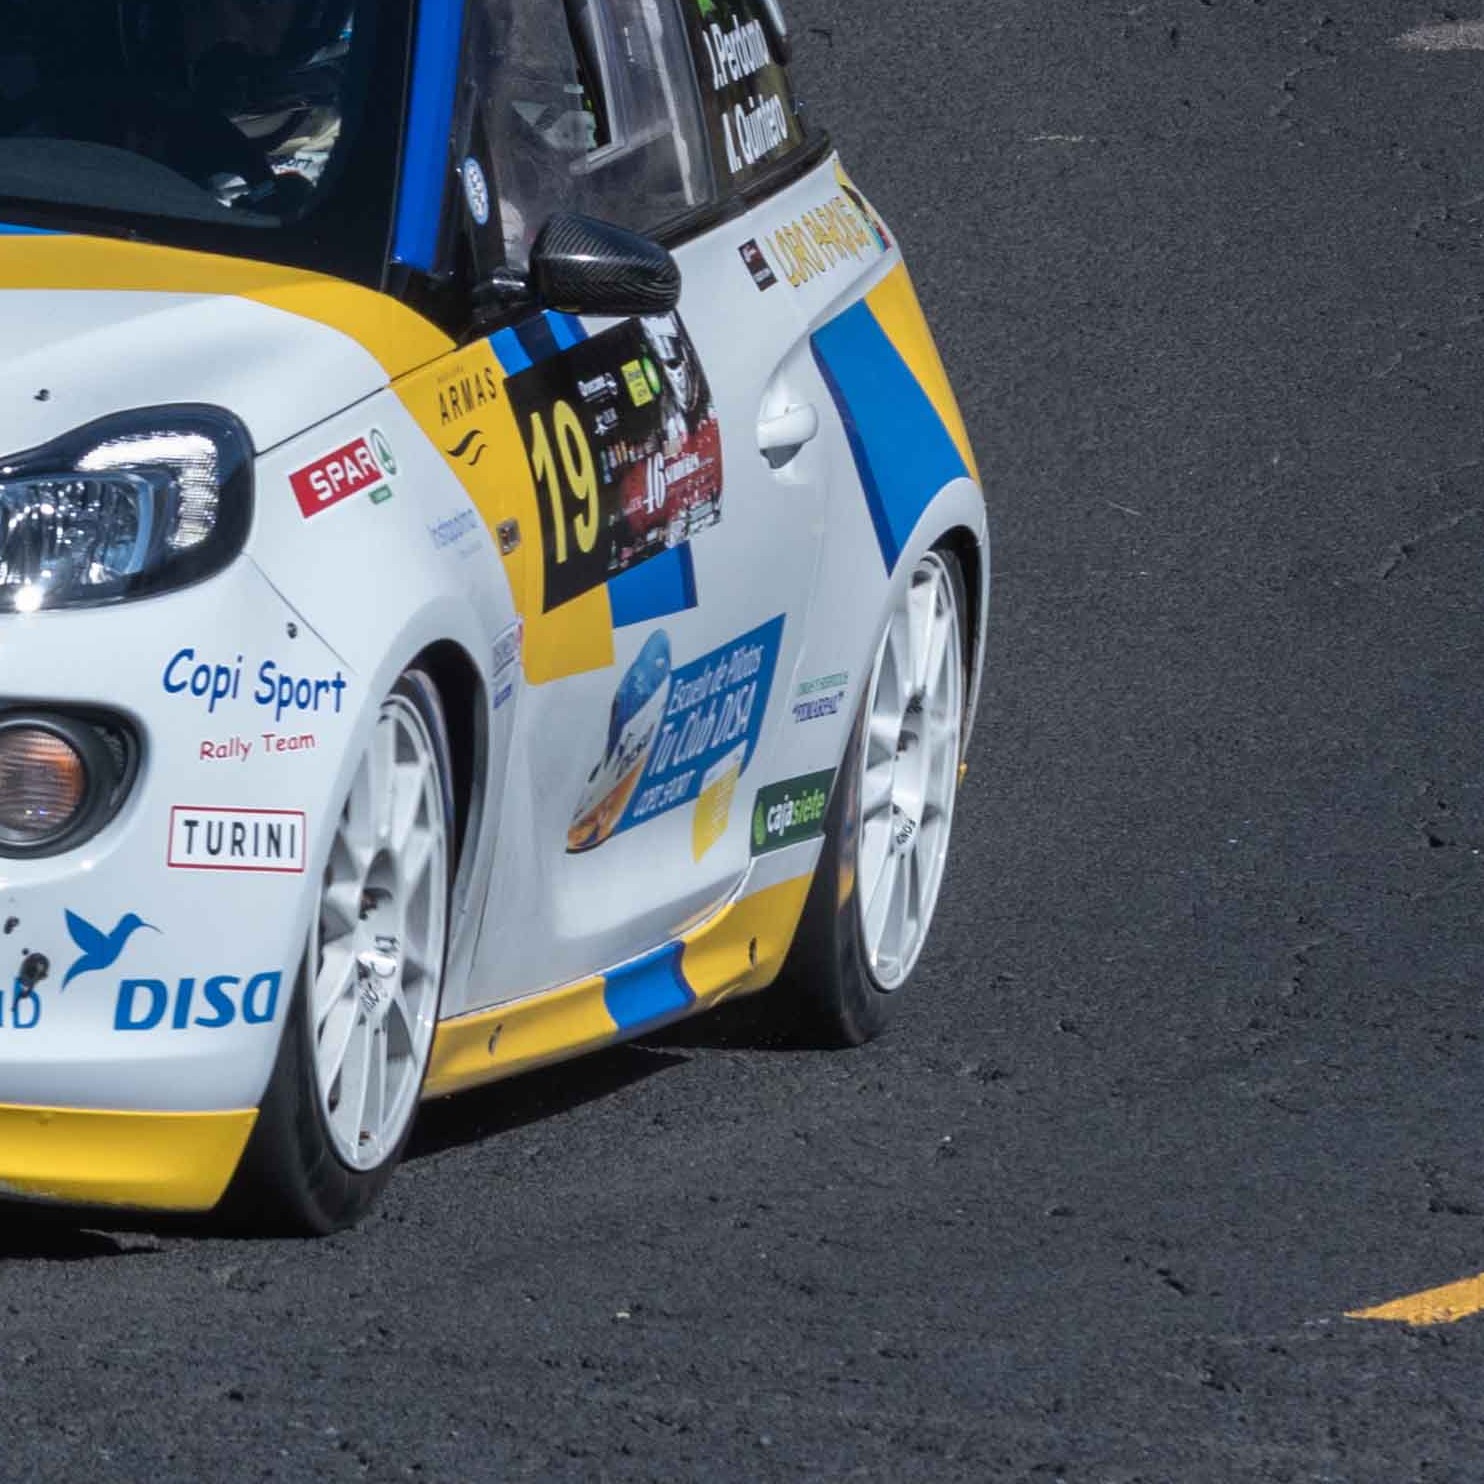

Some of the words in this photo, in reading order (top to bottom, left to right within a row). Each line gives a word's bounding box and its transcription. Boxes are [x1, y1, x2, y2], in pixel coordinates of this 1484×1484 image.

[437, 367, 498, 425] ARMAS
[308, 445, 377, 502] SPAR
[530, 399, 600, 565] 19
[161, 648, 244, 714] Copi
[254, 660, 347, 722] Sport
[199, 737, 254, 762] Rally
[261, 732, 316, 753] Team
[647, 722, 677, 777] Tu
[671, 698, 717, 767] Club
[711, 680, 758, 749] DISA
[183, 819, 296, 859] TURINI
[767, 788, 826, 836] cajasiete
